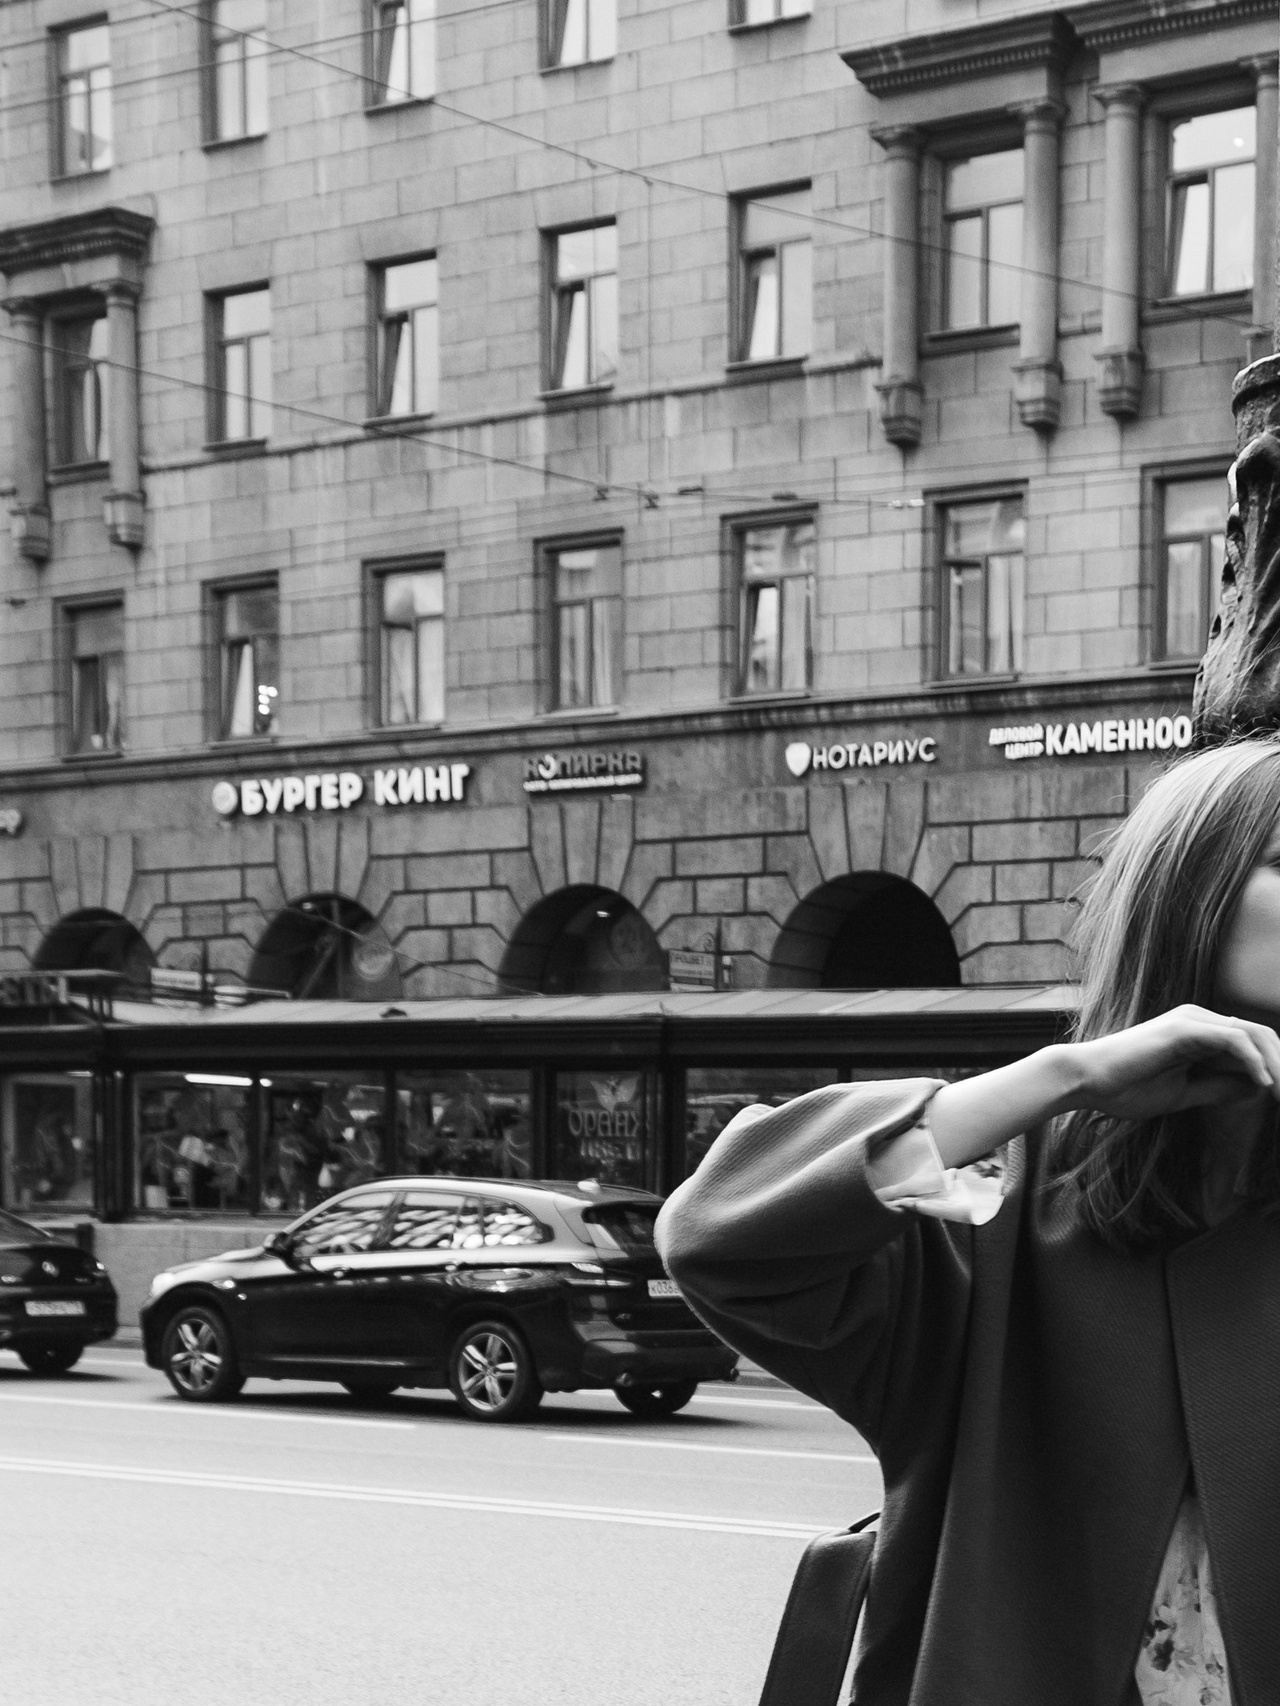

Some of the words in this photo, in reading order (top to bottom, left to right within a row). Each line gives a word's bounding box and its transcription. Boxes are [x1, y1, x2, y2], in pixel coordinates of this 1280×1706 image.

[989, 723, 1044, 746] ДЕЛОВОЙ
[812, 736, 937, 770] НОТАРИУС
[1005, 741, 1045, 760] ЦЕНТР
[240, 772, 363, 815] БУРГЕР
[373, 763, 470, 806] КИНГ
